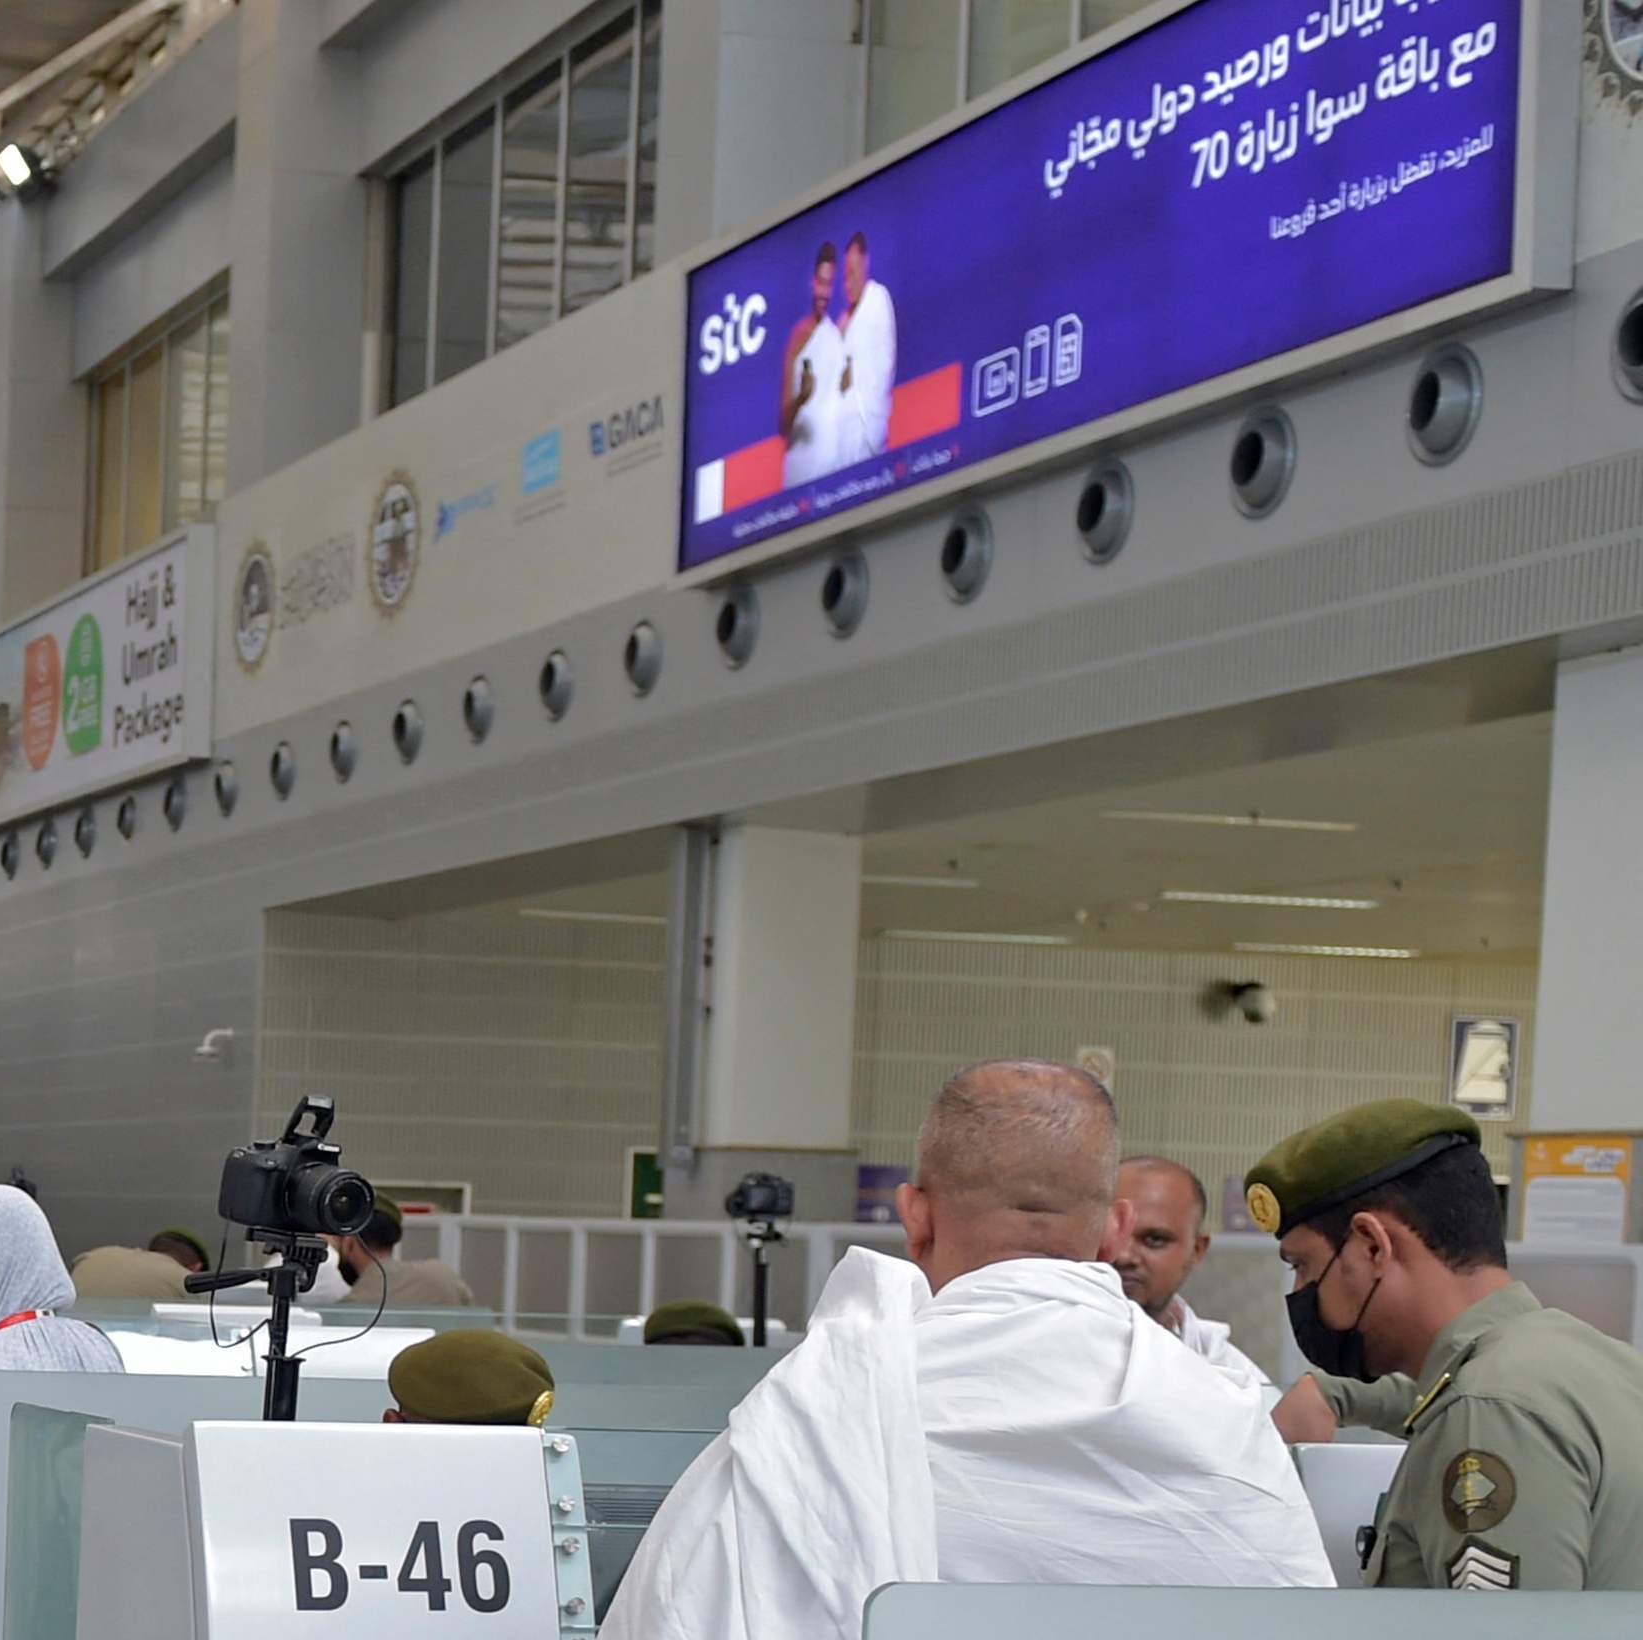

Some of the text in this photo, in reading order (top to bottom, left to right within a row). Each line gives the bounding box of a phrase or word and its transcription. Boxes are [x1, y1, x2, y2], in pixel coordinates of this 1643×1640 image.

[1201, 34, 1291, 106] ورصيد
[1126, 83, 1195, 159] دولي
[1190, 22, 1498, 188] مع باقة سوا زيارة 70
[1316, 181, 1347, 221] أحد
[698, 292, 768, 376] stc
[608, 395, 664, 449] GACA
[125, 571, 158, 630] Hajj
[122, 620, 178, 687] Umrah
[113, 692, 184, 750] Package
[288, 1517, 512, 1613] B-46
